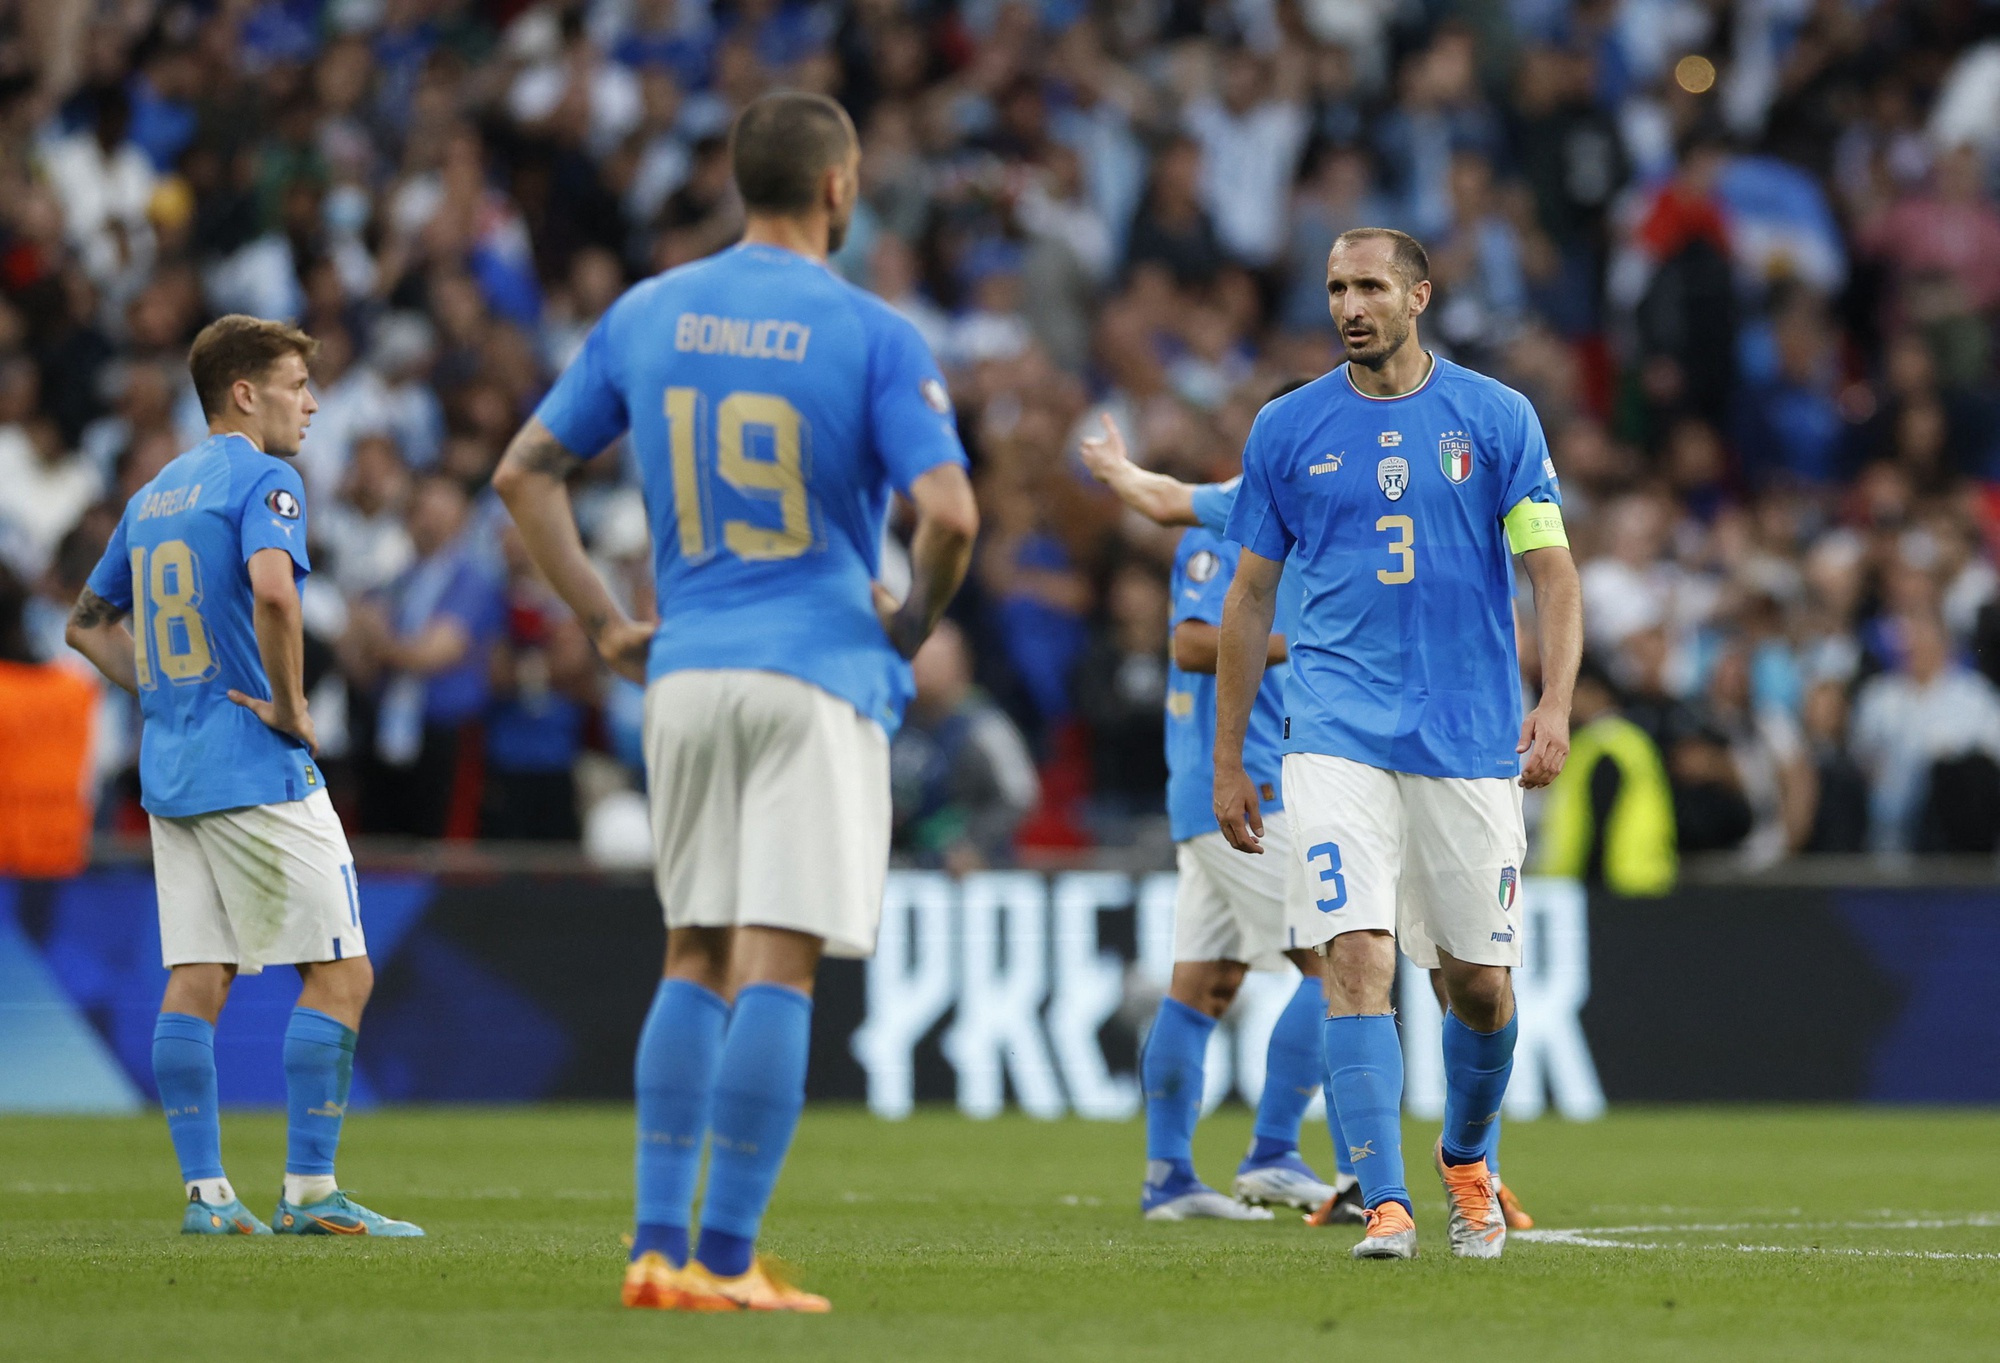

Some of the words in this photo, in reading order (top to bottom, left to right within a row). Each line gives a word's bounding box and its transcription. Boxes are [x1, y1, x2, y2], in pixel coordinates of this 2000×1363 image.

[675, 312, 811, 363] BONUCCI
[664, 385, 827, 566] 19
[1309, 461, 1338, 476] PUMA
[1442, 441, 1470, 450] ITALIA
[1375, 514, 1415, 585] 3
[131, 540, 221, 691] 18
[340, 862, 361, 928] 1
[1306, 841, 1348, 913] 3
[1490, 932, 1513, 943] PUMA
